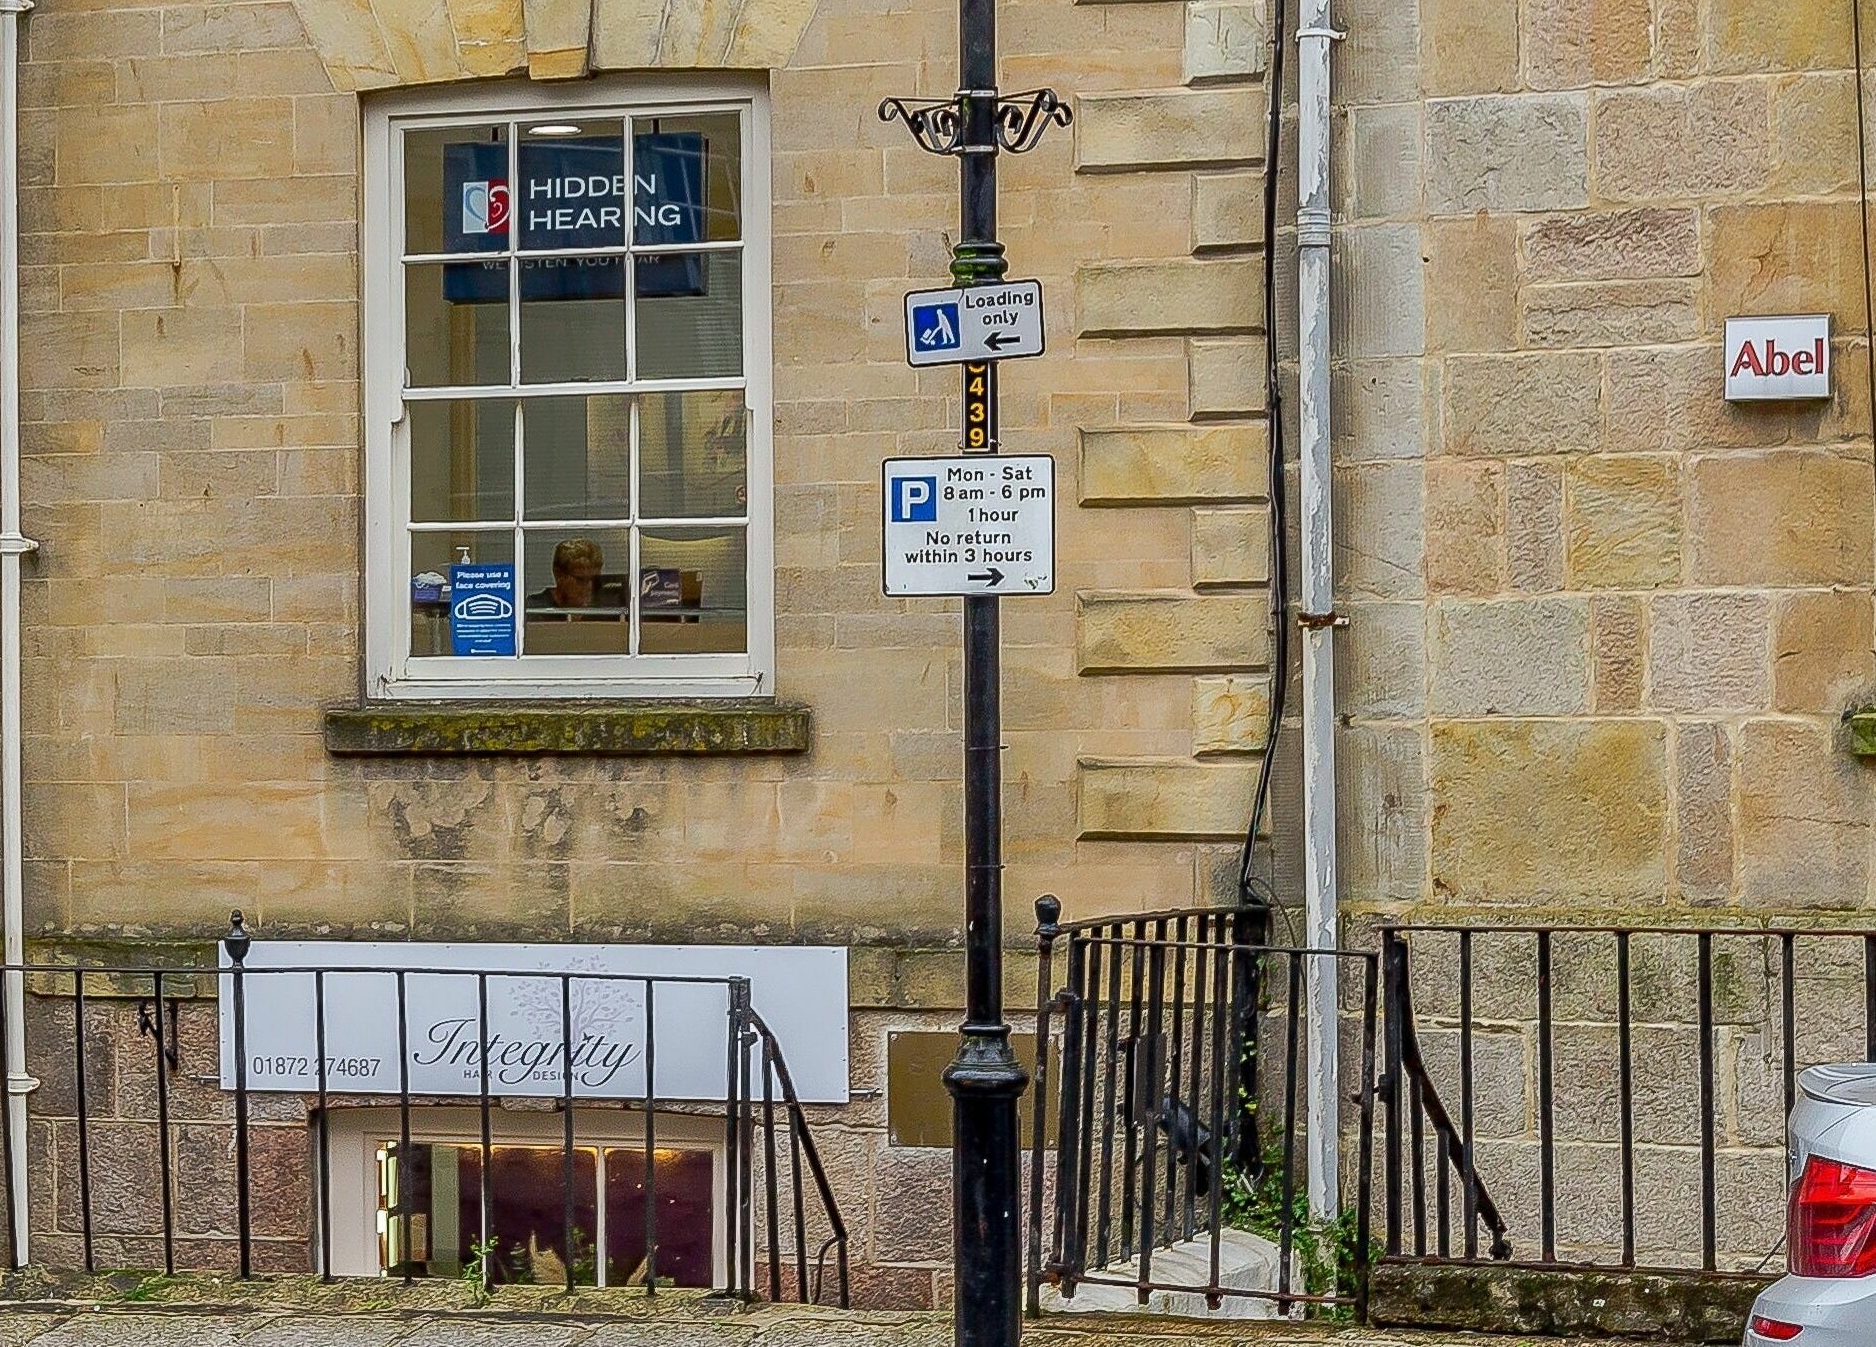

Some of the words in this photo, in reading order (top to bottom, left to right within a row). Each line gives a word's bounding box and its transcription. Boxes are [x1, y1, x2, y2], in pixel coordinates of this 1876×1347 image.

[530, 174, 656, 199] HIDDEN
[530, 204, 681, 231] HEARNG
[508, 257, 568, 270] ISTEN
[965, 291, 1034, 309] Loading
[982, 310, 1019, 325] only
[1729, 338, 1824, 377] Abel
[969, 361, 985, 447] 439
[947, 467, 984, 482] Mon
[1002, 466, 1033, 481] Sat
[1002, 485, 1013, 499] 6
[1019, 487, 1046, 502] pm
[968, 508, 975, 522] 1
[979, 508, 1019, 522] hour
[926, 531, 951, 545] No
[957, 530, 1012, 545] return
[905, 549, 958, 563] within
[964, 548, 976, 562] 3
[983, 548, 1033, 562] hours
[475, 581, 511, 590] covering
[413, 1018, 642, 1087] Integrity
[253, 1056, 309, 1076] 01872
[463, 1070, 493, 1079] HAR
[532, 1070, 579, 1081] DESIN
